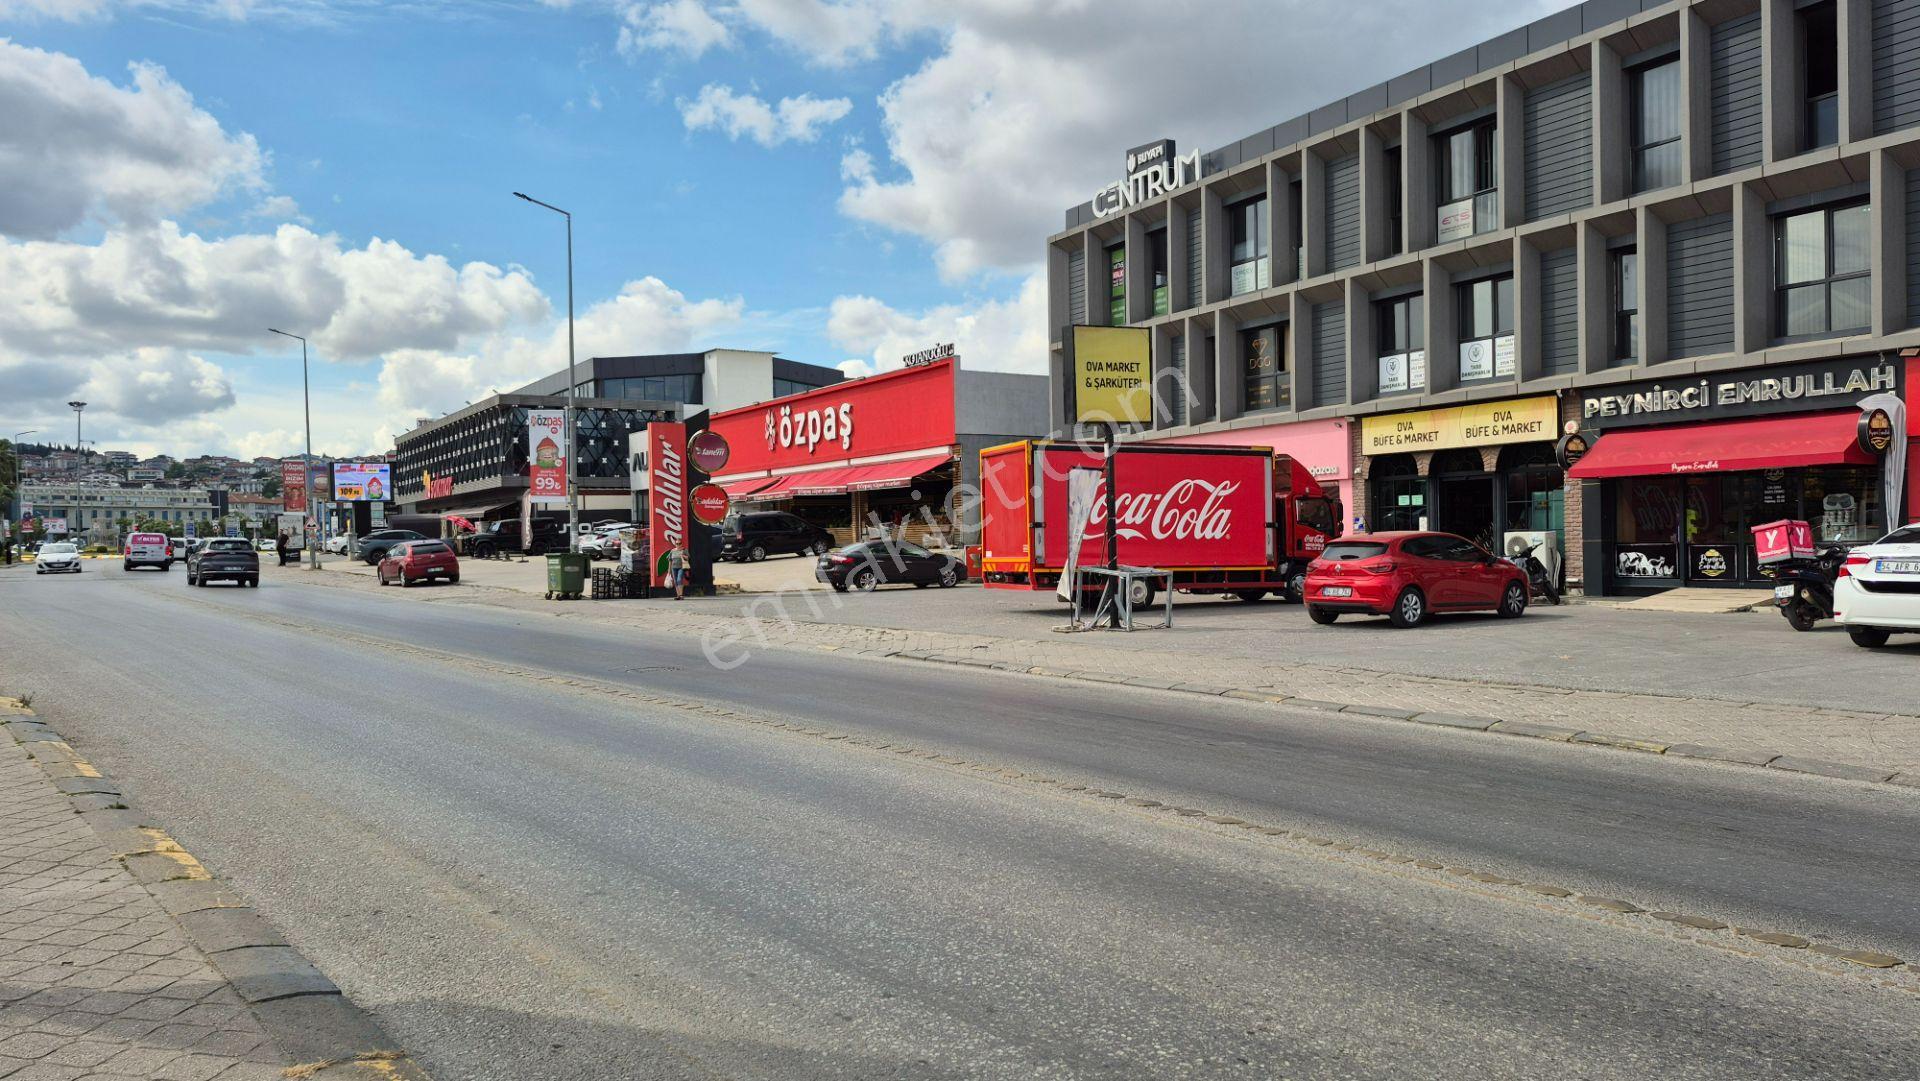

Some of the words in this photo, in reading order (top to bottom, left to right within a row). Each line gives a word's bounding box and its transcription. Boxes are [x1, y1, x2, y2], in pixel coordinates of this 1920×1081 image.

[1092, 147, 1200, 218] CENTRUM
[1086, 361, 1103, 372] OVA
[1106, 362, 1141, 372] MARKET
[1085, 377, 1092, 388] &
[1585, 379, 1709, 419] PEYNİRCİ
[1718, 365, 1895, 404] EMRULLAH
[1493, 411, 1512, 422] OVA
[780, 403, 853, 454] özpaş
[1397, 421, 1413, 432] OVA
[1465, 425, 1490, 438] BÜFE
[1492, 426, 1500, 436] &
[1502, 421, 1542, 434] MARKET
[1373, 434, 1395, 446] BÜFE
[1396, 434, 1403, 445] &
[1404, 431, 1439, 443] MARKET
[654, 440, 682, 545] adalılar
[1084, 478, 1241, 540] oca-Cola
[1765, 530, 1778, 548] Y
[1795, 527, 1804, 545] Y
[1895, 563, 1910, 571] AFR
